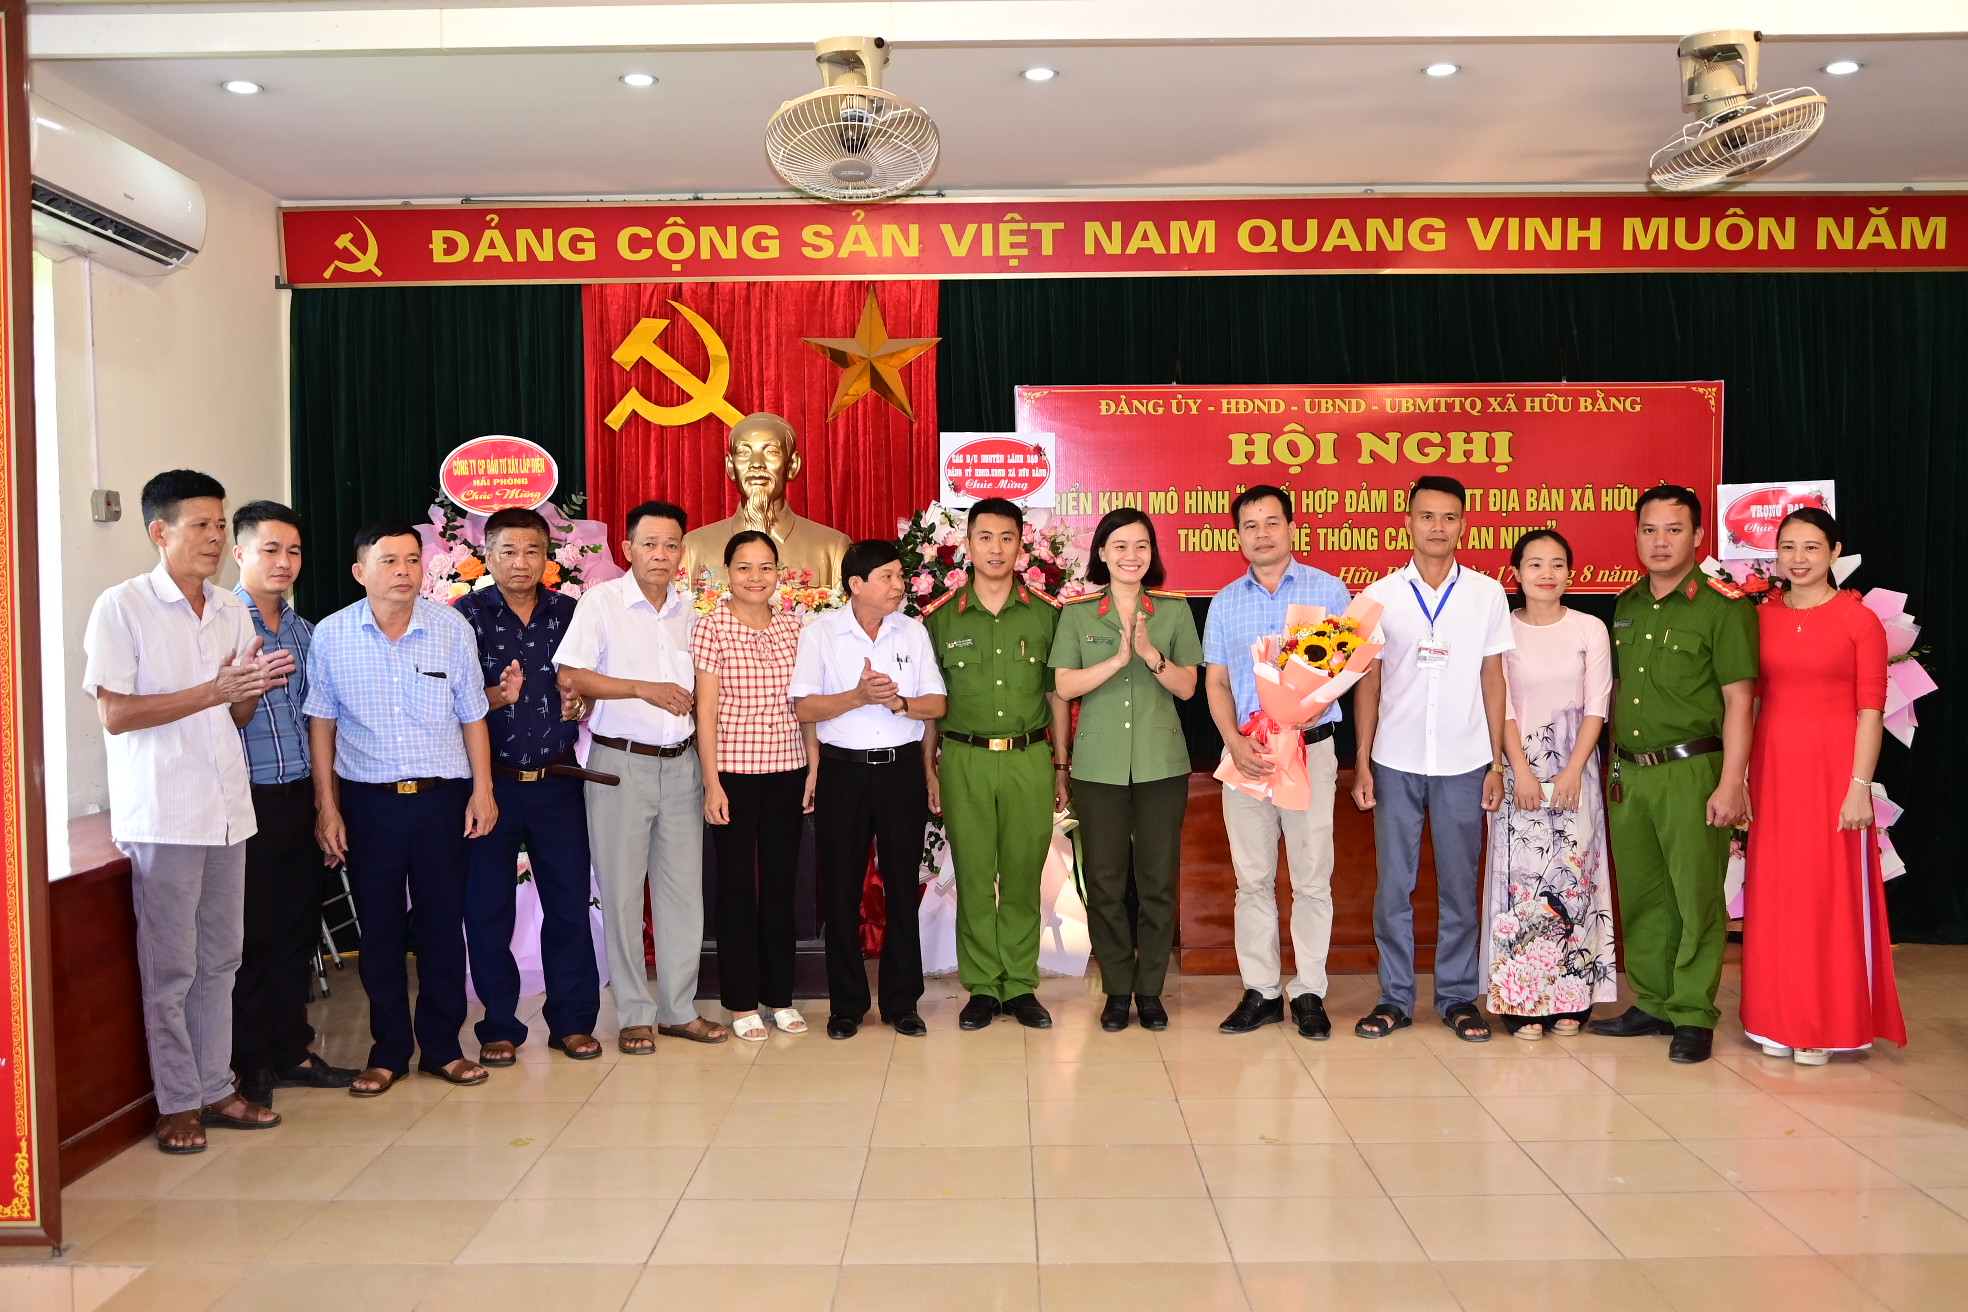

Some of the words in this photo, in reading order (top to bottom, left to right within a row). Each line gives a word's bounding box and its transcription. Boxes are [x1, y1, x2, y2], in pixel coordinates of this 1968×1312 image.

[429, 214, 596, 263] ĐẢNG
[616, 217, 780, 271] CỘNG
[801, 209, 924, 260] SẢN
[939, 213, 1065, 267] VIỆT
[1084, 220, 1216, 255] NAM
[1237, 218, 1446, 253] QUANG
[1466, 217, 1602, 251] VINH
[1623, 207, 1796, 251] MUÔN
[1816, 207, 1947, 250] NĂM
[1099, 395, 1165, 415] ĐẢNG
[1170, 394, 1202, 415] ỦY
[1220, 398, 1287, 414] HĐND
[1303, 398, 1367, 414] UBND
[1384, 397, 1482, 416] UBMTTQ
[1487, 394, 1519, 413] XÃ
[1524, 393, 1574, 413] HỮU
[1578, 390, 1643, 413] BẰNG
[1228, 422, 1339, 475] HỘI
[1356, 431, 1514, 474] NGHỊ
[453, 456, 469, 476] CÔNG
[469, 459, 477, 476] TY
[478, 459, 486, 475] CP
[473, 476, 490, 487] HẢI
[493, 477, 529, 486] PHÒNG
[965, 479, 993, 489] Chúc
[994, 479, 1029, 491] Mừng
[461, 489, 493, 502] Chúc
[495, 488, 541, 502] Mừng
[1098, 491, 1142, 514] KHAI
[1149, 486, 1179, 514] MÔ
[1184, 485, 1230, 514] HÌNH
[1301, 487, 1339, 518] HỢP
[1345, 482, 1388, 513] ĐẢM
[1488, 488, 1521, 517] ĐỊA
[1526, 483, 1565, 512] BÀN
[1570, 484, 1596, 512] XÃ
[1601, 484, 1639, 512] HỮU
[1750, 504, 1782, 520] TRỌNG
[1177, 523, 1240, 552] THÔNG
[1317, 519, 1380, 551] THỐNG
[1468, 526, 1494, 549] AN
[1744, 522, 1774, 533] Chúc
[1339, 566, 1380, 585] Hữu
[1579, 565, 1595, 583] 8
